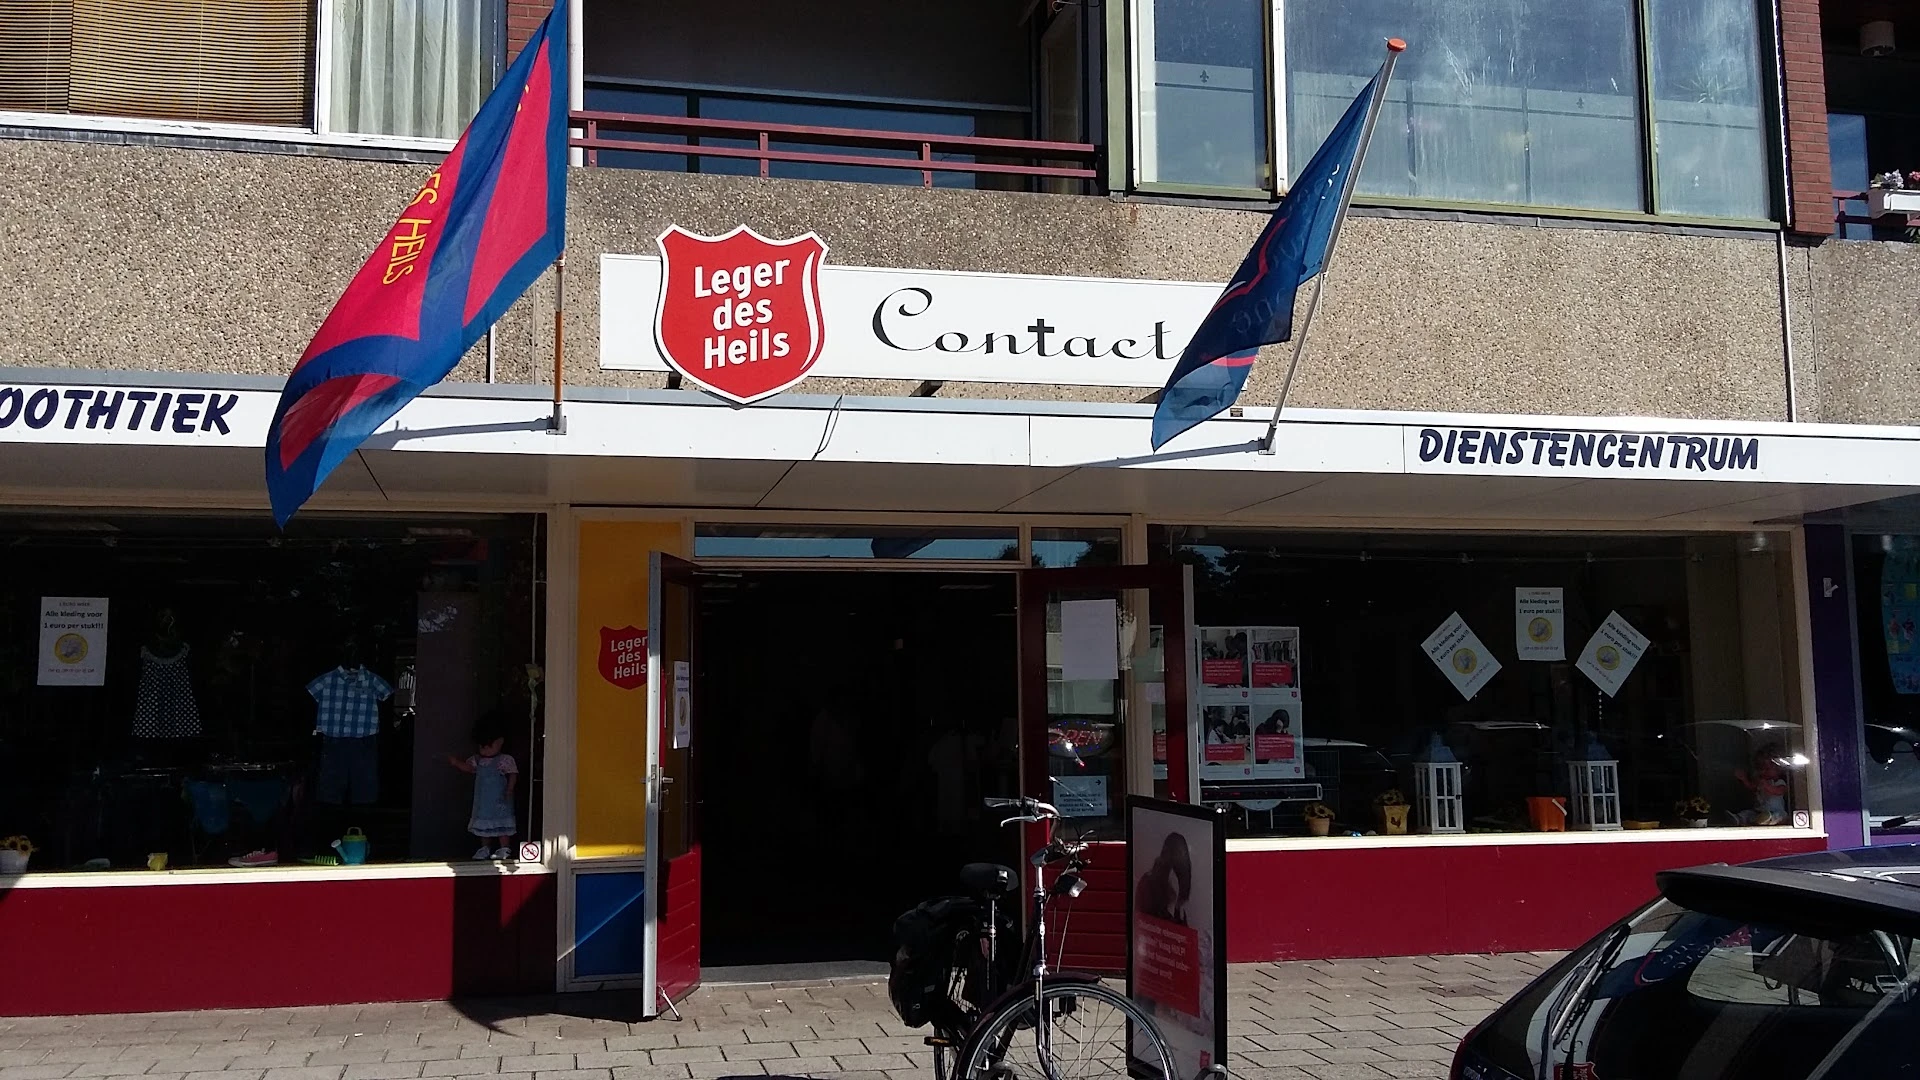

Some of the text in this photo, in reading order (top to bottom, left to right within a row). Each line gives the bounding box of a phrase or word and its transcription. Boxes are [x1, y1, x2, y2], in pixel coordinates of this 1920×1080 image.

[382, 218, 432, 285] HEILS
[694, 259, 791, 300] Leger
[713, 298, 773, 331] des
[872, 287, 1186, 360] Contact
[704, 328, 791, 370] Heils
[1419, 428, 1759, 472] DIENSTENCENTRUM
[611, 635, 648, 652] Leger
[617, 651, 641, 665] des
[613, 662, 647, 679] Heils
